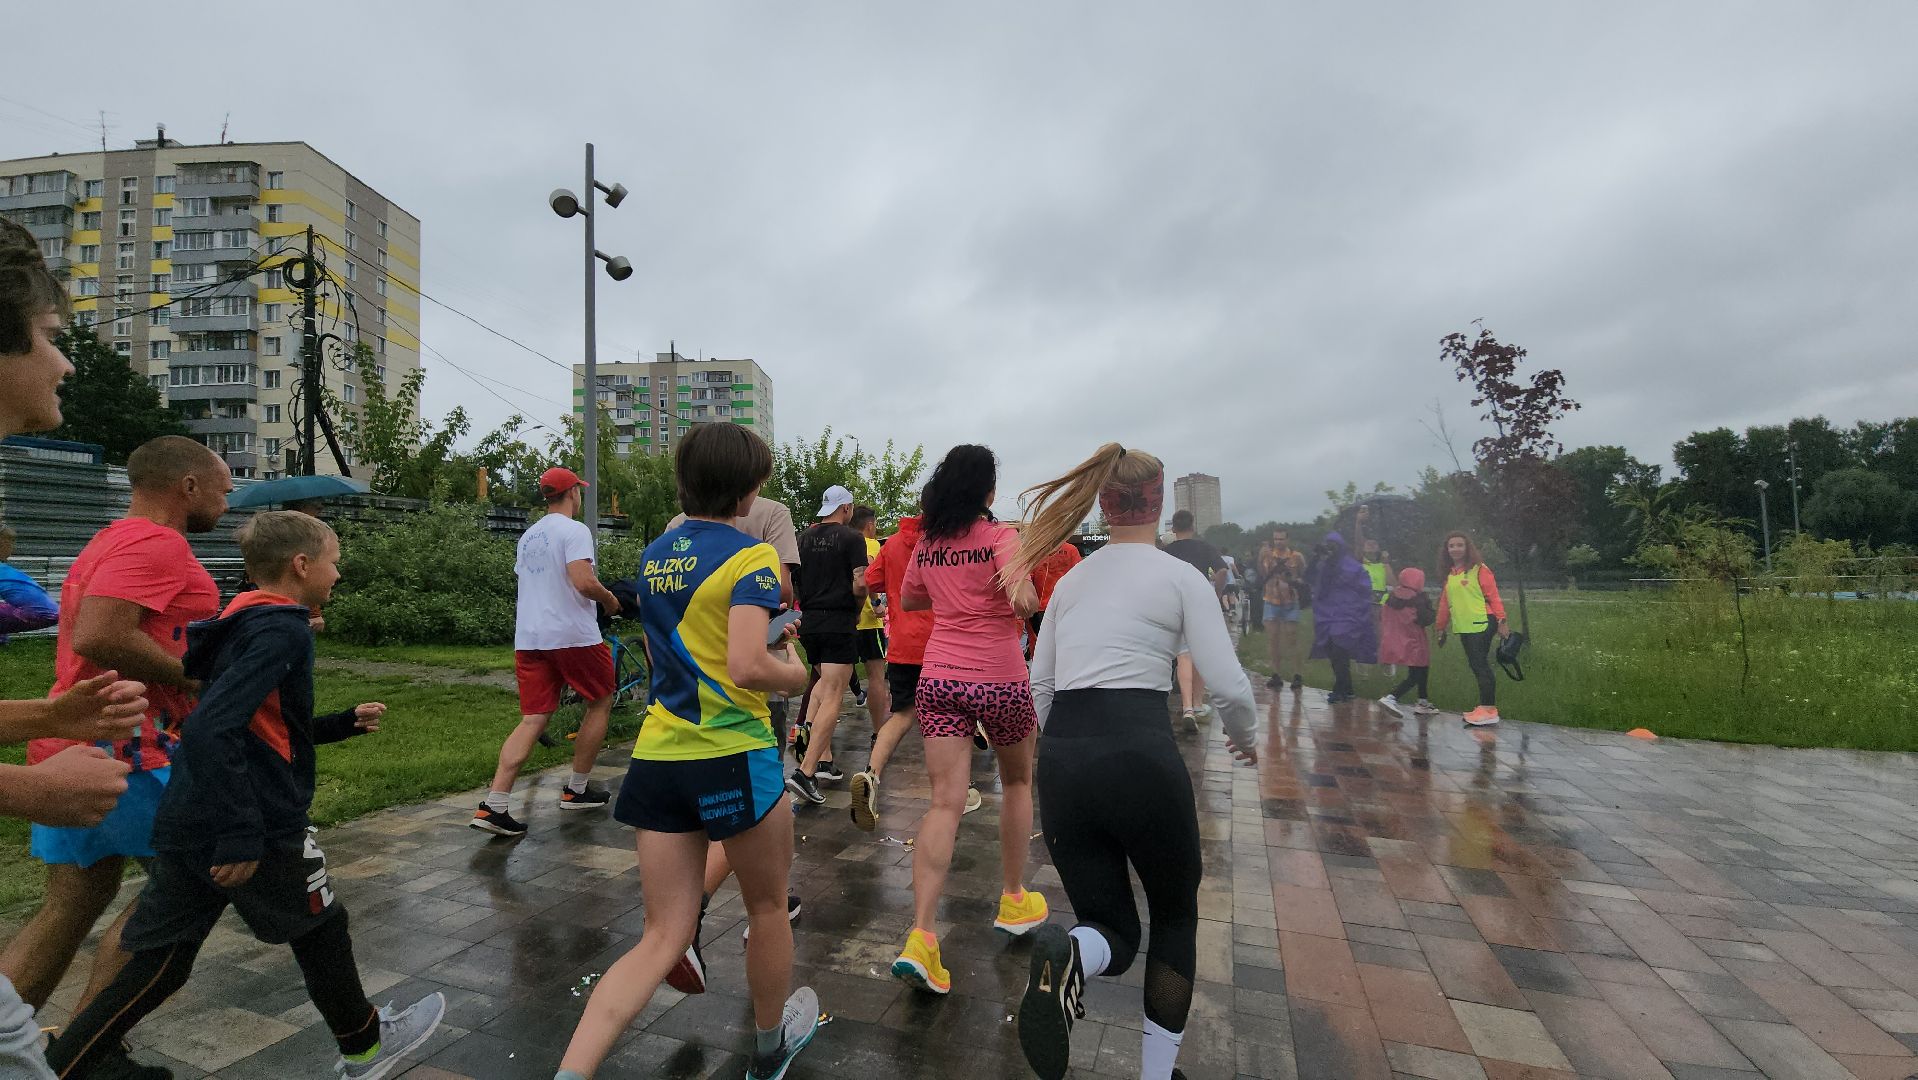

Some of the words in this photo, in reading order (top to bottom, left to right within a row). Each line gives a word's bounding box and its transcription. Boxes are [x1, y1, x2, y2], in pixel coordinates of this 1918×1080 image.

[643, 556, 698, 576] BLIZKO
[647, 574, 688, 595] TRAIL
[755, 575, 776, 585] BLIZKO
[699, 788, 743, 806] UNKNOWN
